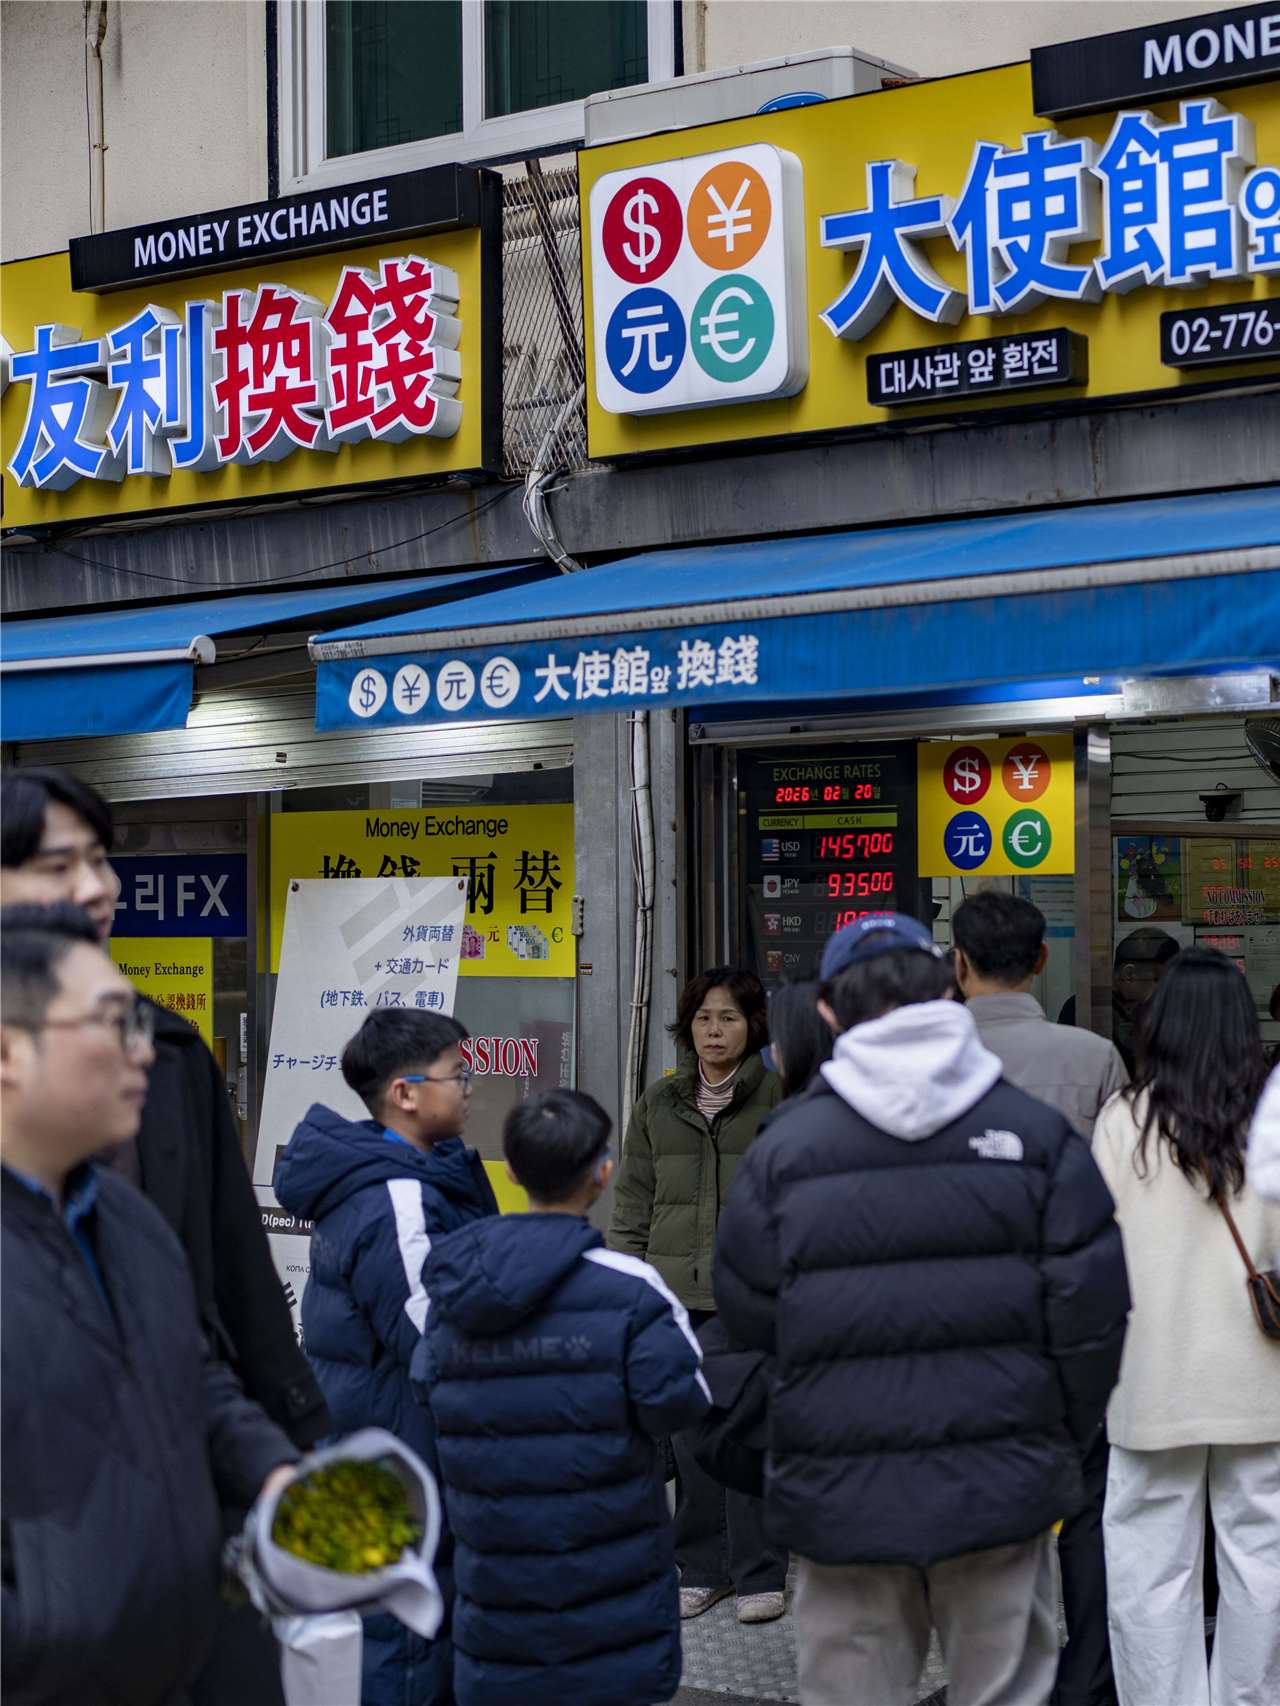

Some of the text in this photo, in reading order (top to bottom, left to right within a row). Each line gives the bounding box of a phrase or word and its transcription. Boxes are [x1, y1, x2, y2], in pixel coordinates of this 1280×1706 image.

[133, 189, 389, 268] MONEY EXCHANGE
[622, 178, 753, 274] $ ¥
[620, 286, 756, 378] 元 €
[879, 338, 1059, 395] 대사관 앞 환전
[444, 672, 466, 701] 元
[773, 764, 881, 781] EXCHANGE RATES
[953, 755, 1041, 794] $ ¥
[365, 815, 508, 840] Money Exchange
[837, 816, 862, 825] CASH
[781, 841, 800, 851] USD
[952, 824, 985, 858] 元
[782, 878, 800, 889] JPY
[782, 916, 802, 927] HKD
[402, 925, 455, 943] 外貨両替
[118, 962, 204, 979] Money Exchange
[386, 958, 449, 975] 交通カード
[272, 1053, 342, 1071] チャージチ
[459, 1036, 539, 1077] SSION
